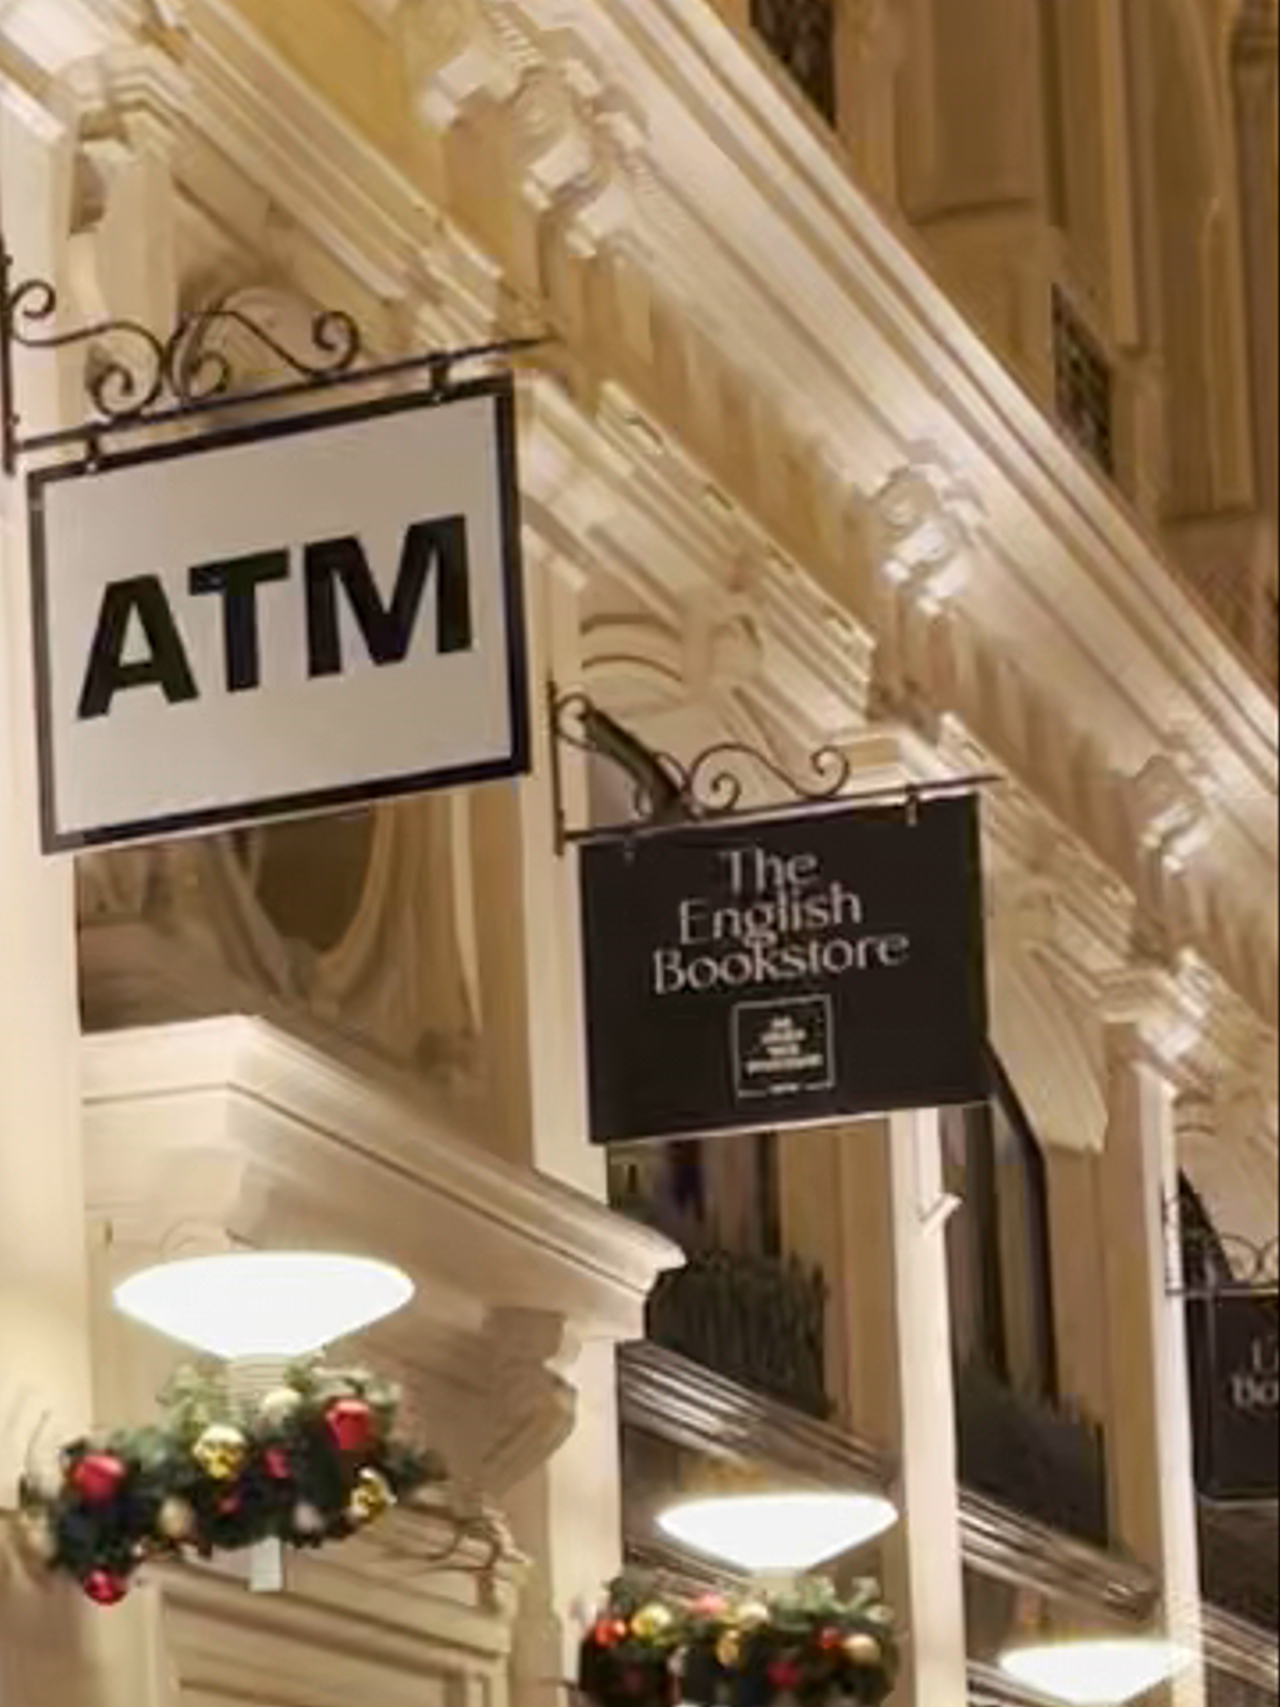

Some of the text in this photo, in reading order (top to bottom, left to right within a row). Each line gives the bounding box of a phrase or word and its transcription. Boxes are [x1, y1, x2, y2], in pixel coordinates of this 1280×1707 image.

[76, 513, 474, 722] ATM
[718, 846, 819, 896] The
[679, 882, 864, 948] English
[653, 931, 910, 995] Bookstore
